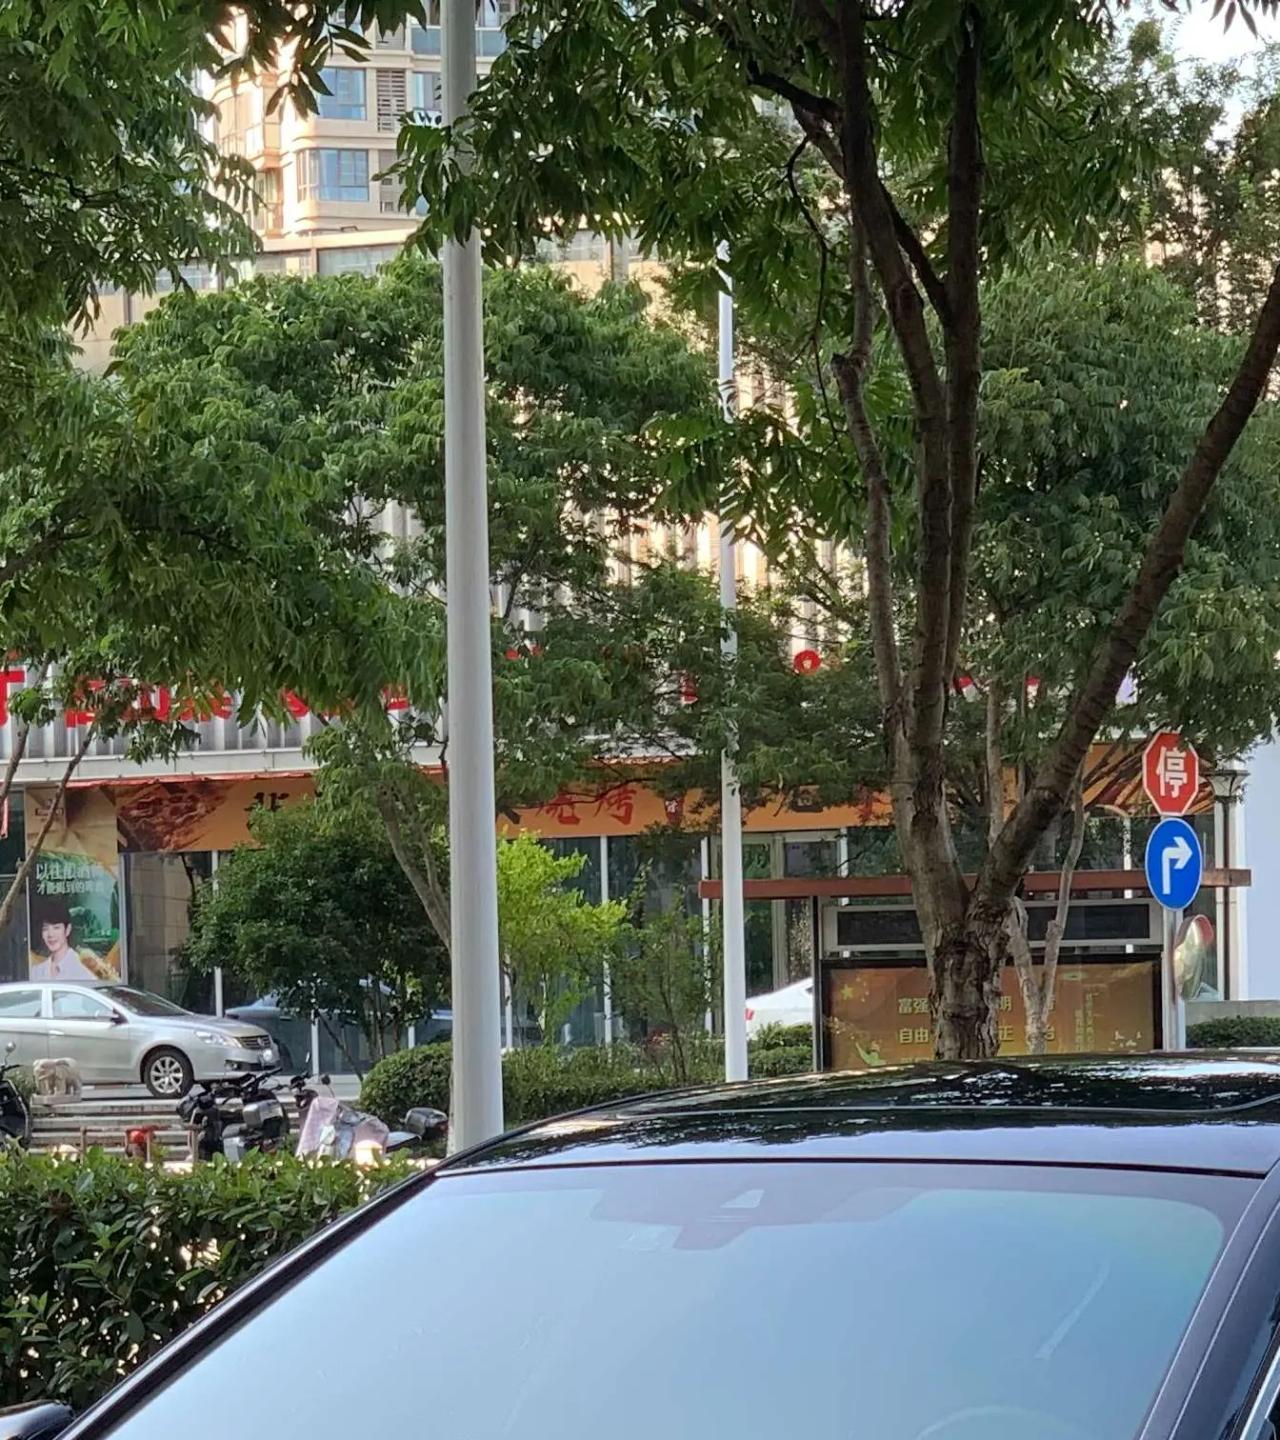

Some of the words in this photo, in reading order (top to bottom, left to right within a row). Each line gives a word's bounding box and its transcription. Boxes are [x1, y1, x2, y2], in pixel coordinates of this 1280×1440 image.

[1156, 746, 1187, 798] 停
[898, 998, 930, 1015] 富强
[898, 1028, 930, 1044] 自由
